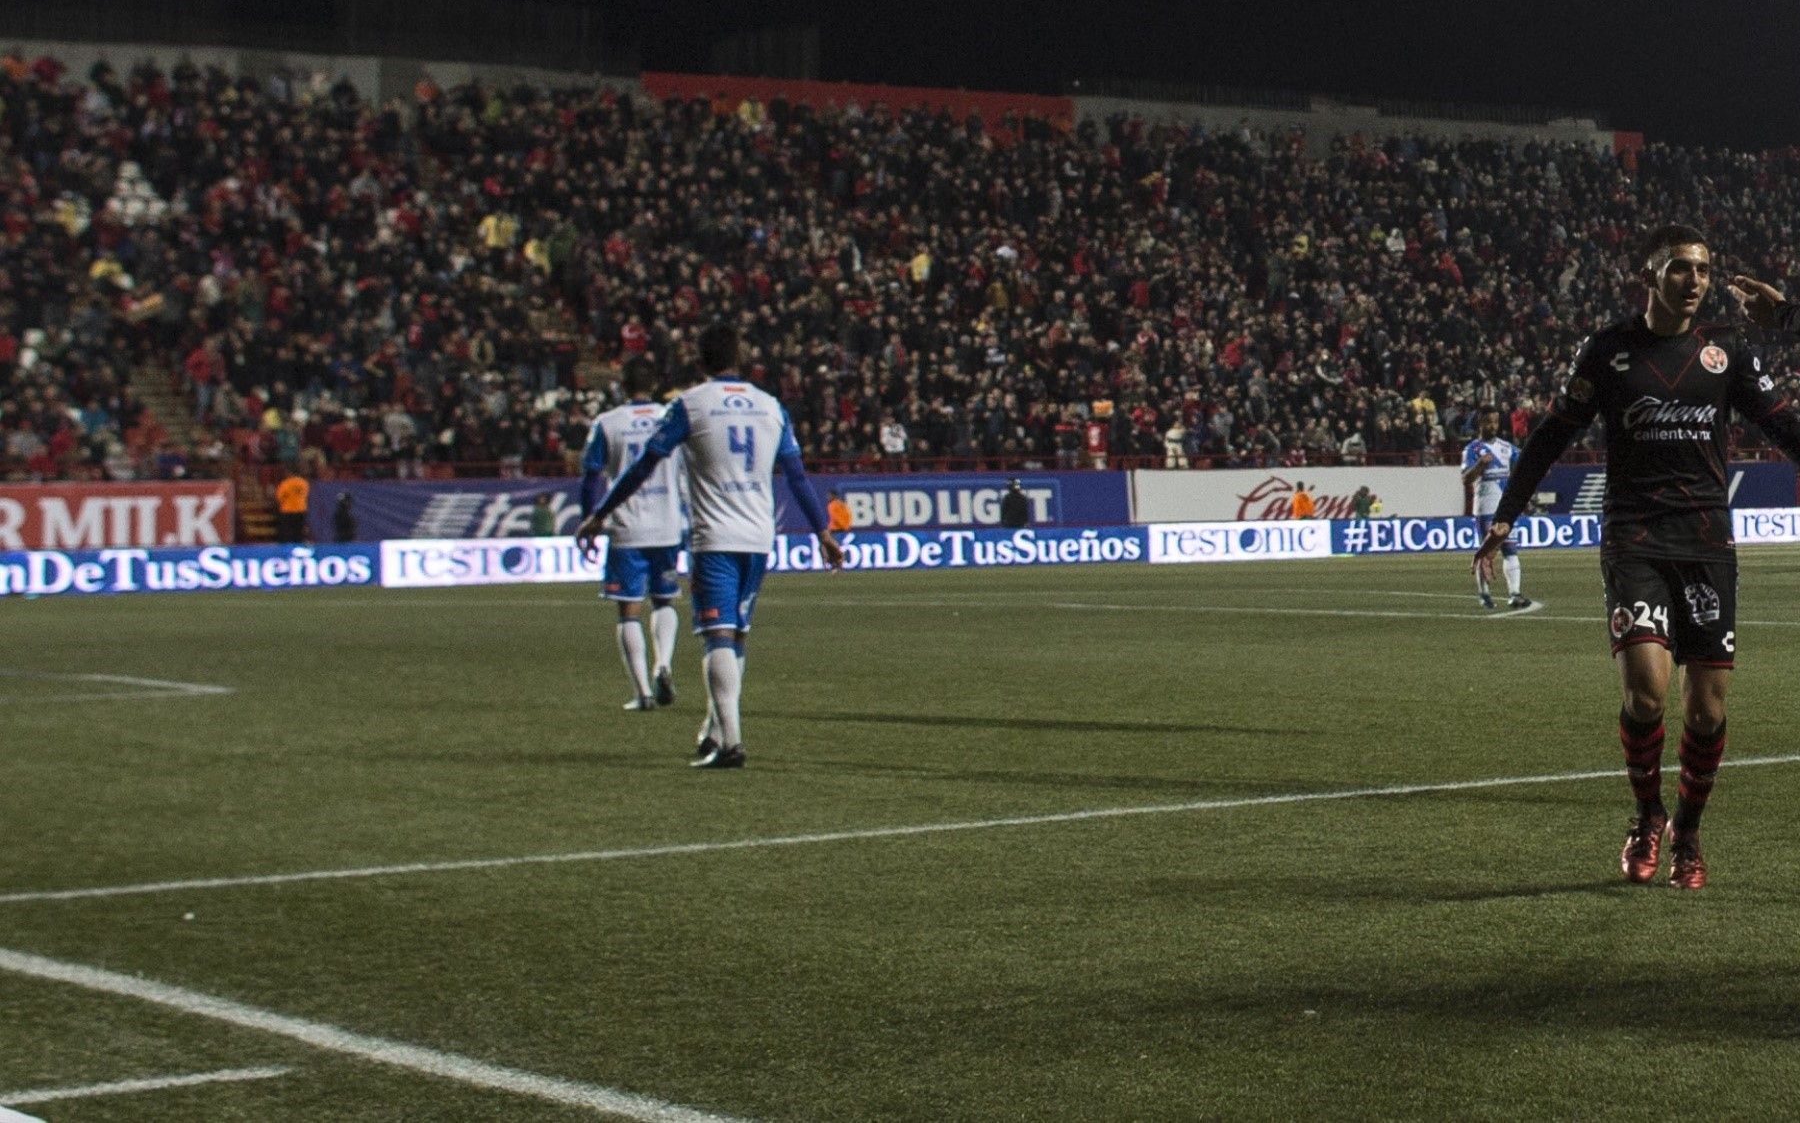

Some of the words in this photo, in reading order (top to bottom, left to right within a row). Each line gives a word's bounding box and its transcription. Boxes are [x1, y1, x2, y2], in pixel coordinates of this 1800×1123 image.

[727, 425, 756, 472] 4
[38, 495, 226, 548] MILK
[844, 491, 933, 527] BUD
[936, 488, 1053, 526] LIGT
[1632, 600, 1670, 637] 24
